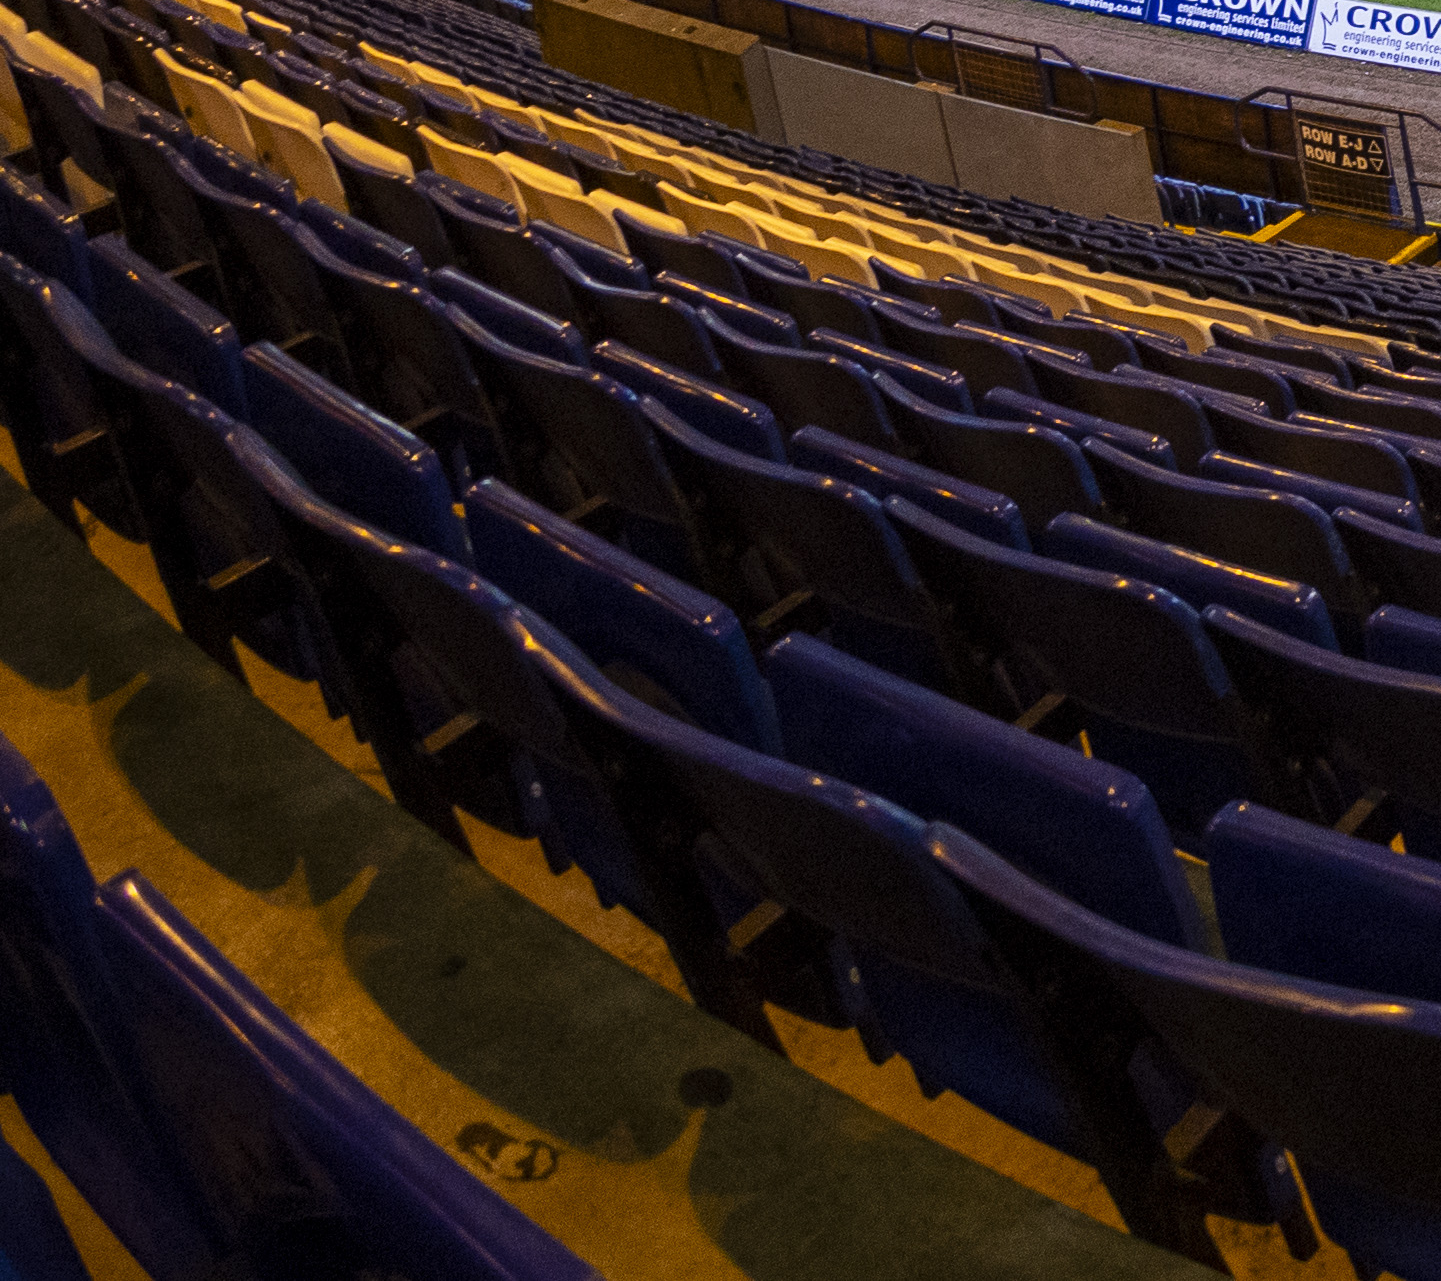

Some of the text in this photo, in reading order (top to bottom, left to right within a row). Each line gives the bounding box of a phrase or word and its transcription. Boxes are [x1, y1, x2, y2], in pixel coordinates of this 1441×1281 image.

[1175, 15, 1302, 47] crown-engineering.co.uk
[1177, 1, 1306, 35] engineering services limited
[1344, 29, 1402, 51] engineering
[1301, 125, 1364, 152] ROW E-J
[1305, 144, 1368, 170] ROW A-D
